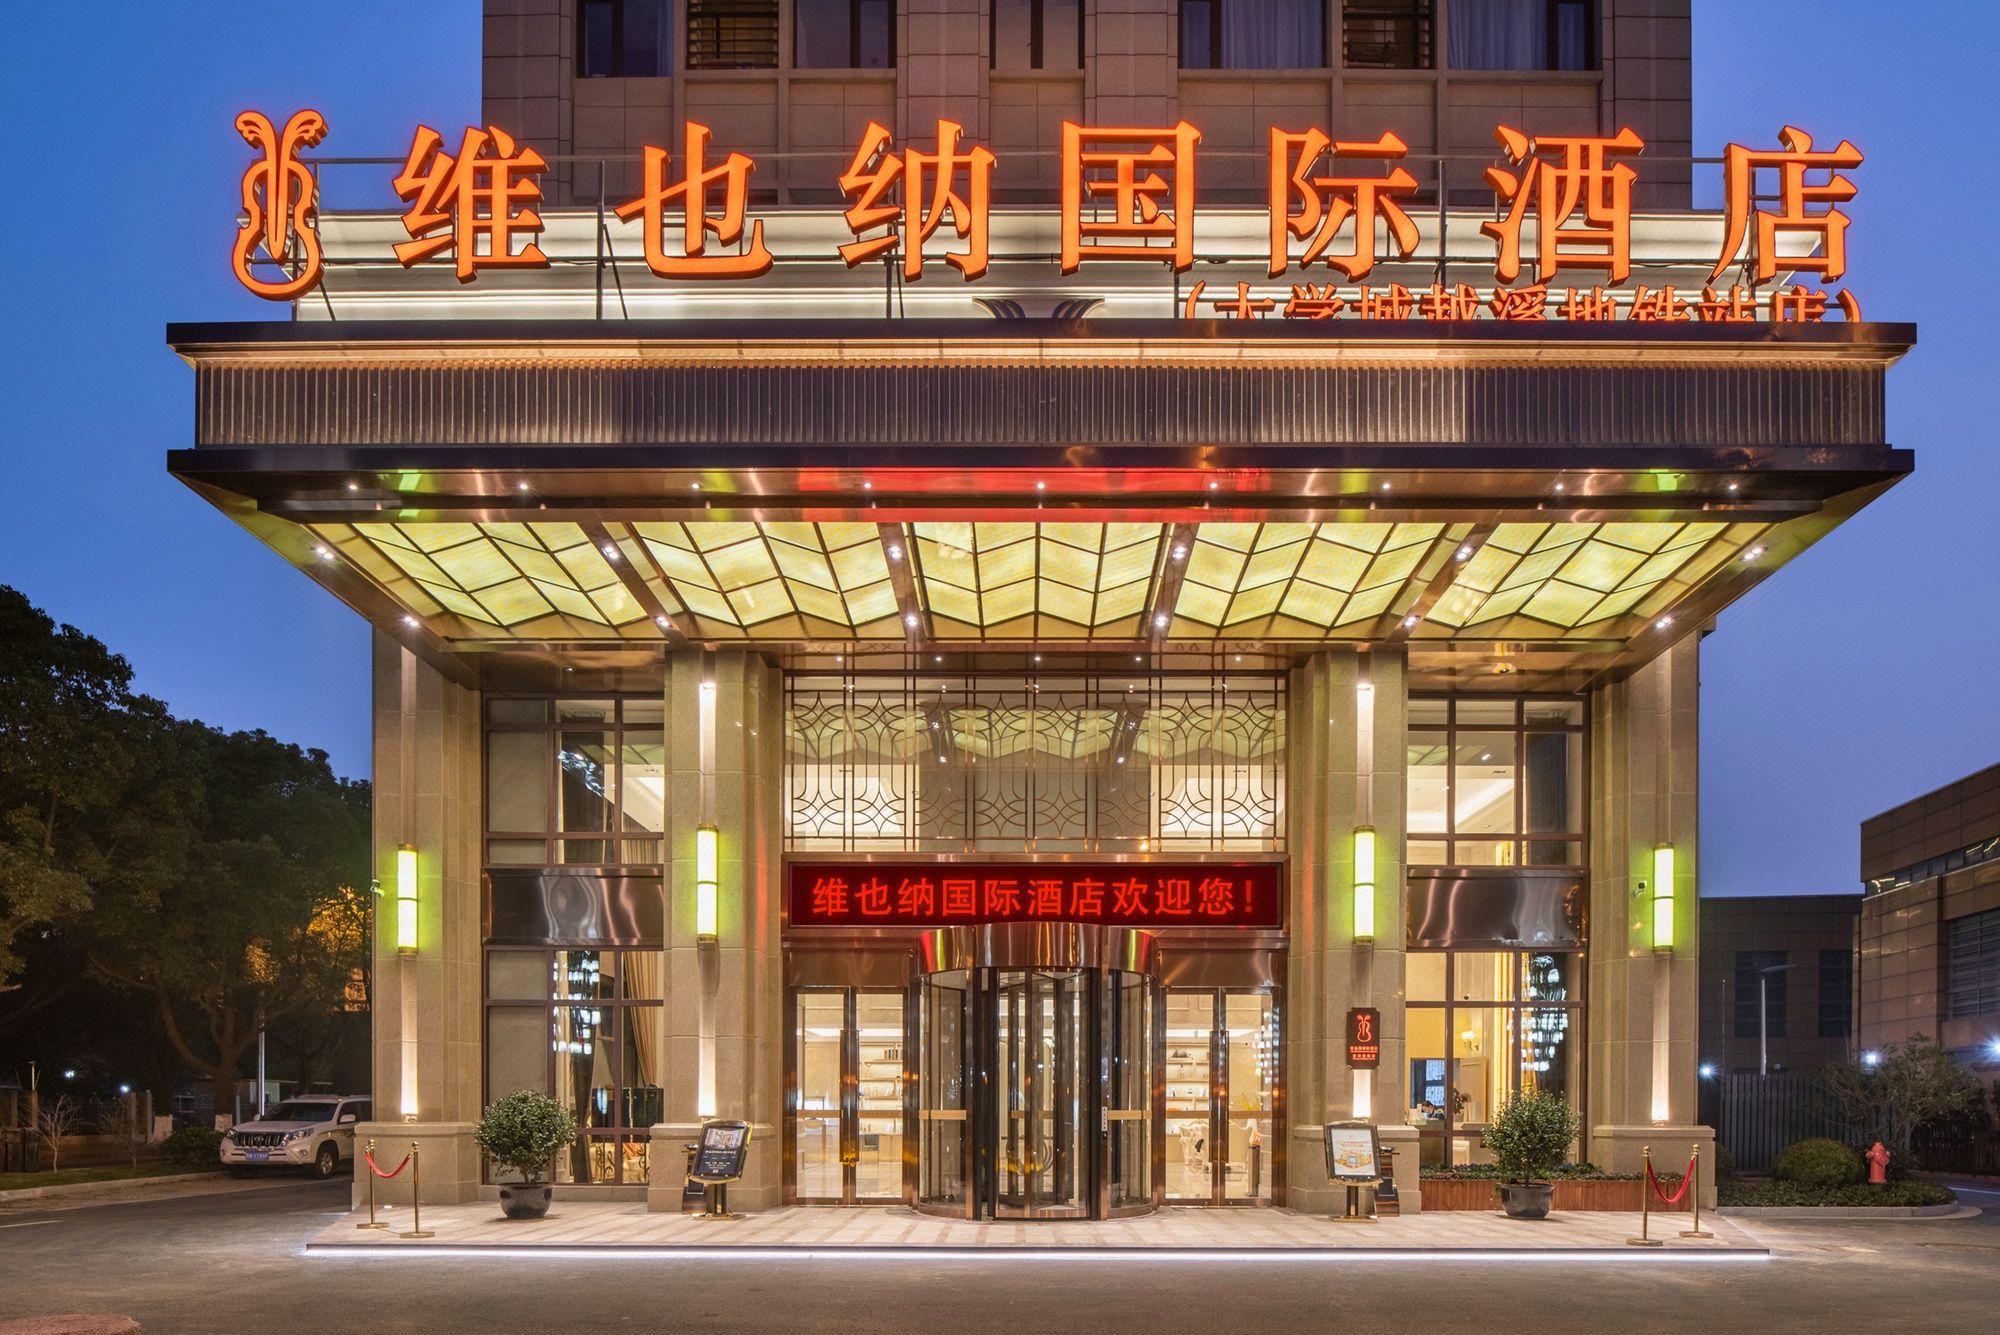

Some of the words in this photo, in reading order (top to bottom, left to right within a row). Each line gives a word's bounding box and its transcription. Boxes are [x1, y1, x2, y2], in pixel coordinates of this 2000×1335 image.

[392, 119, 1864, 285] 维也纳国际酒店
[811, 876, 1255, 918] 维也纳国际酒店欢迎您!
